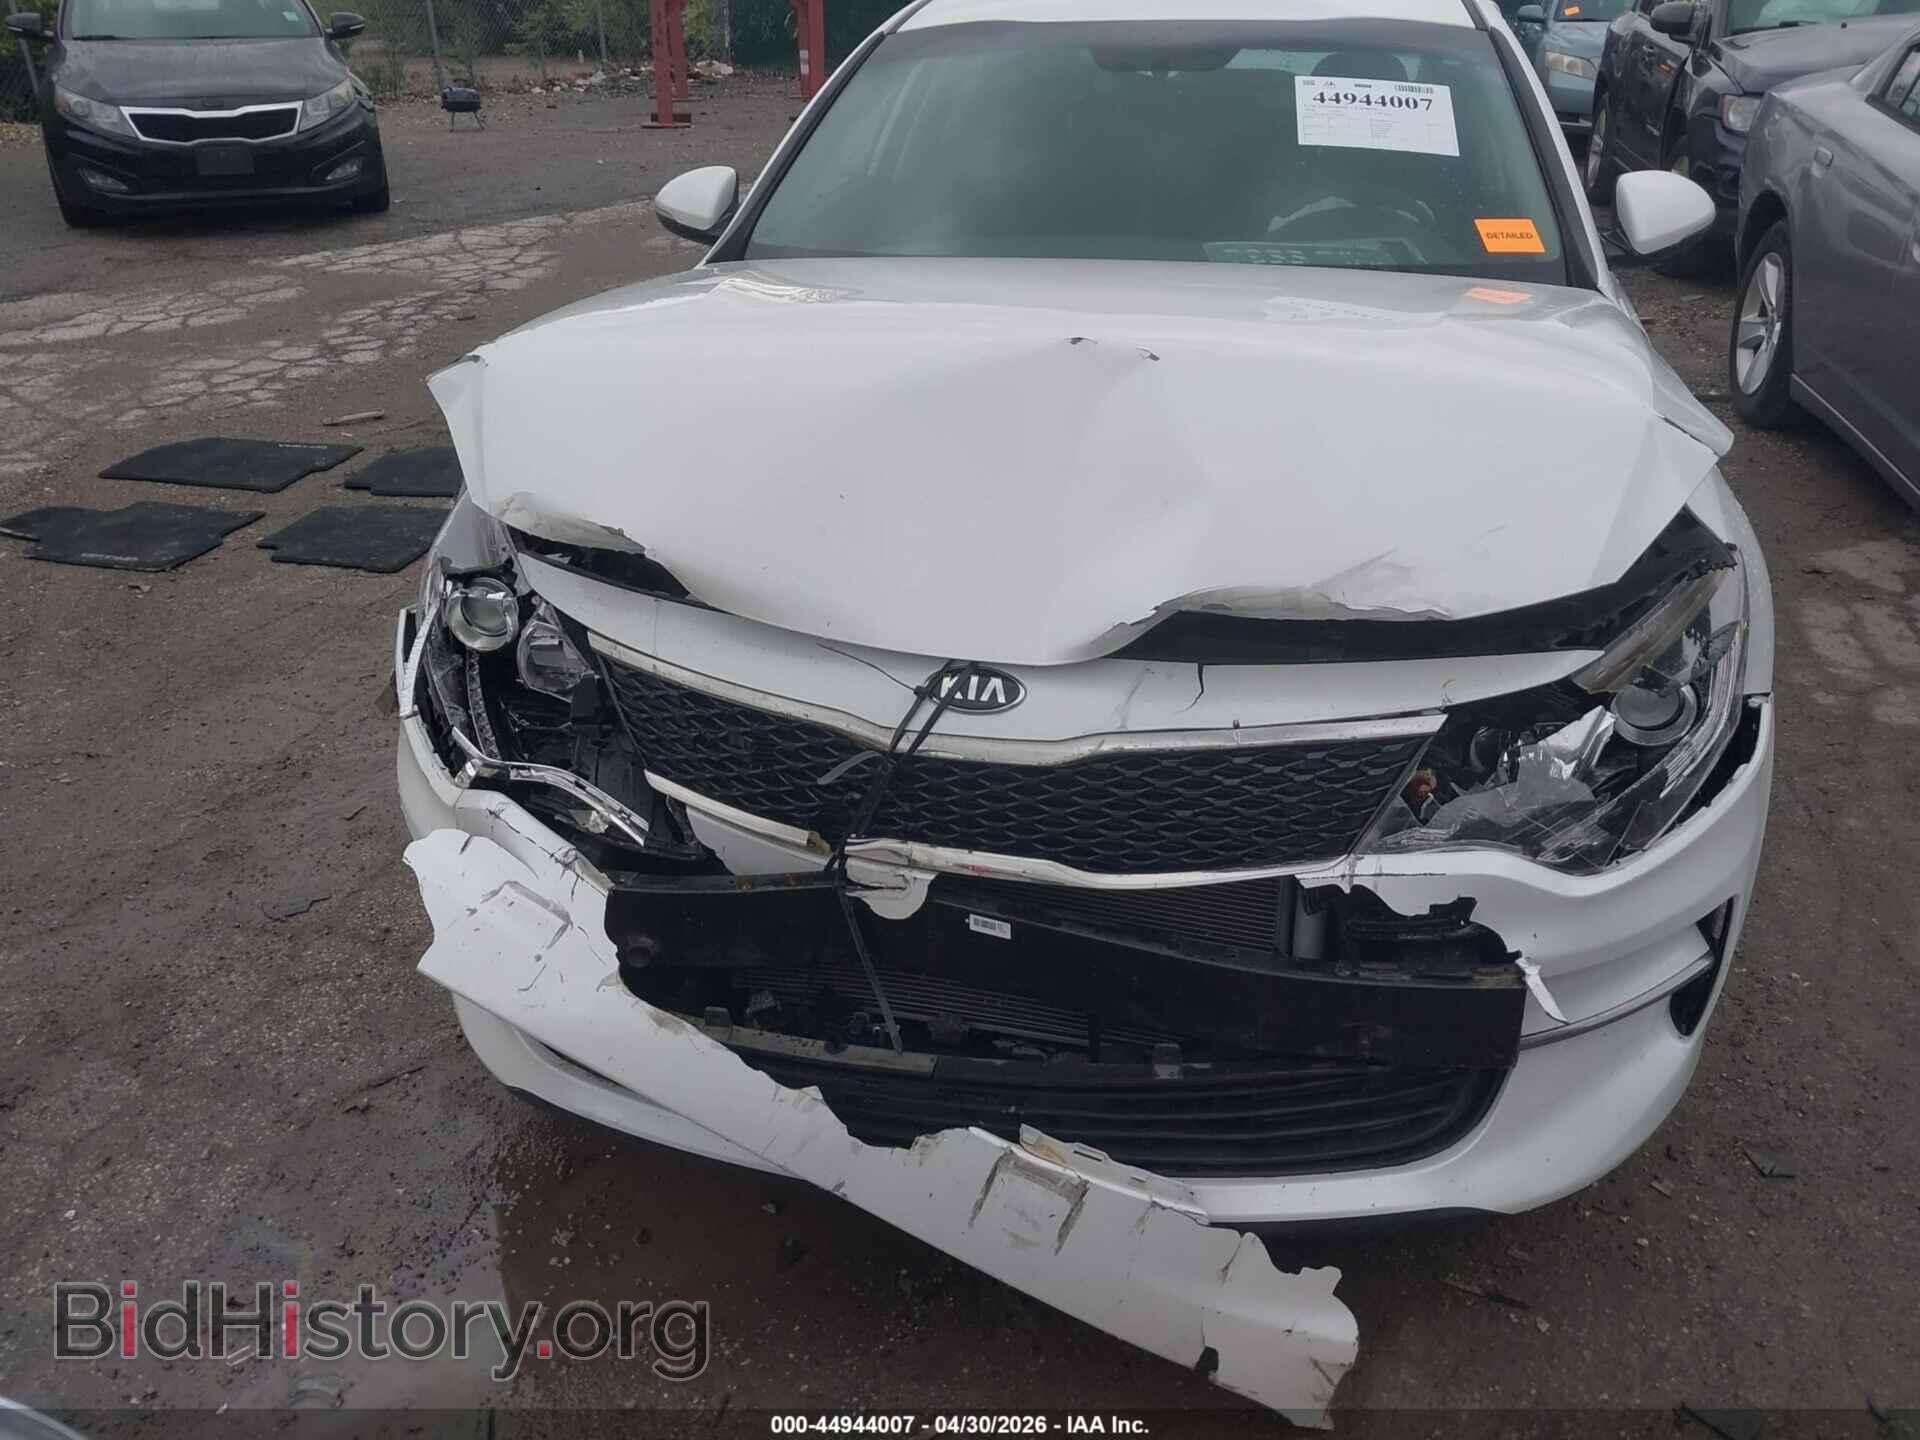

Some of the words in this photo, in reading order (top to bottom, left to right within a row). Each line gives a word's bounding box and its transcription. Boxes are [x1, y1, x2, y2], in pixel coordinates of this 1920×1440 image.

[1313, 91, 1433, 112] 44944007
[1486, 231, 1533, 240] DETAILED
[940, 674, 1006, 704] KIA
